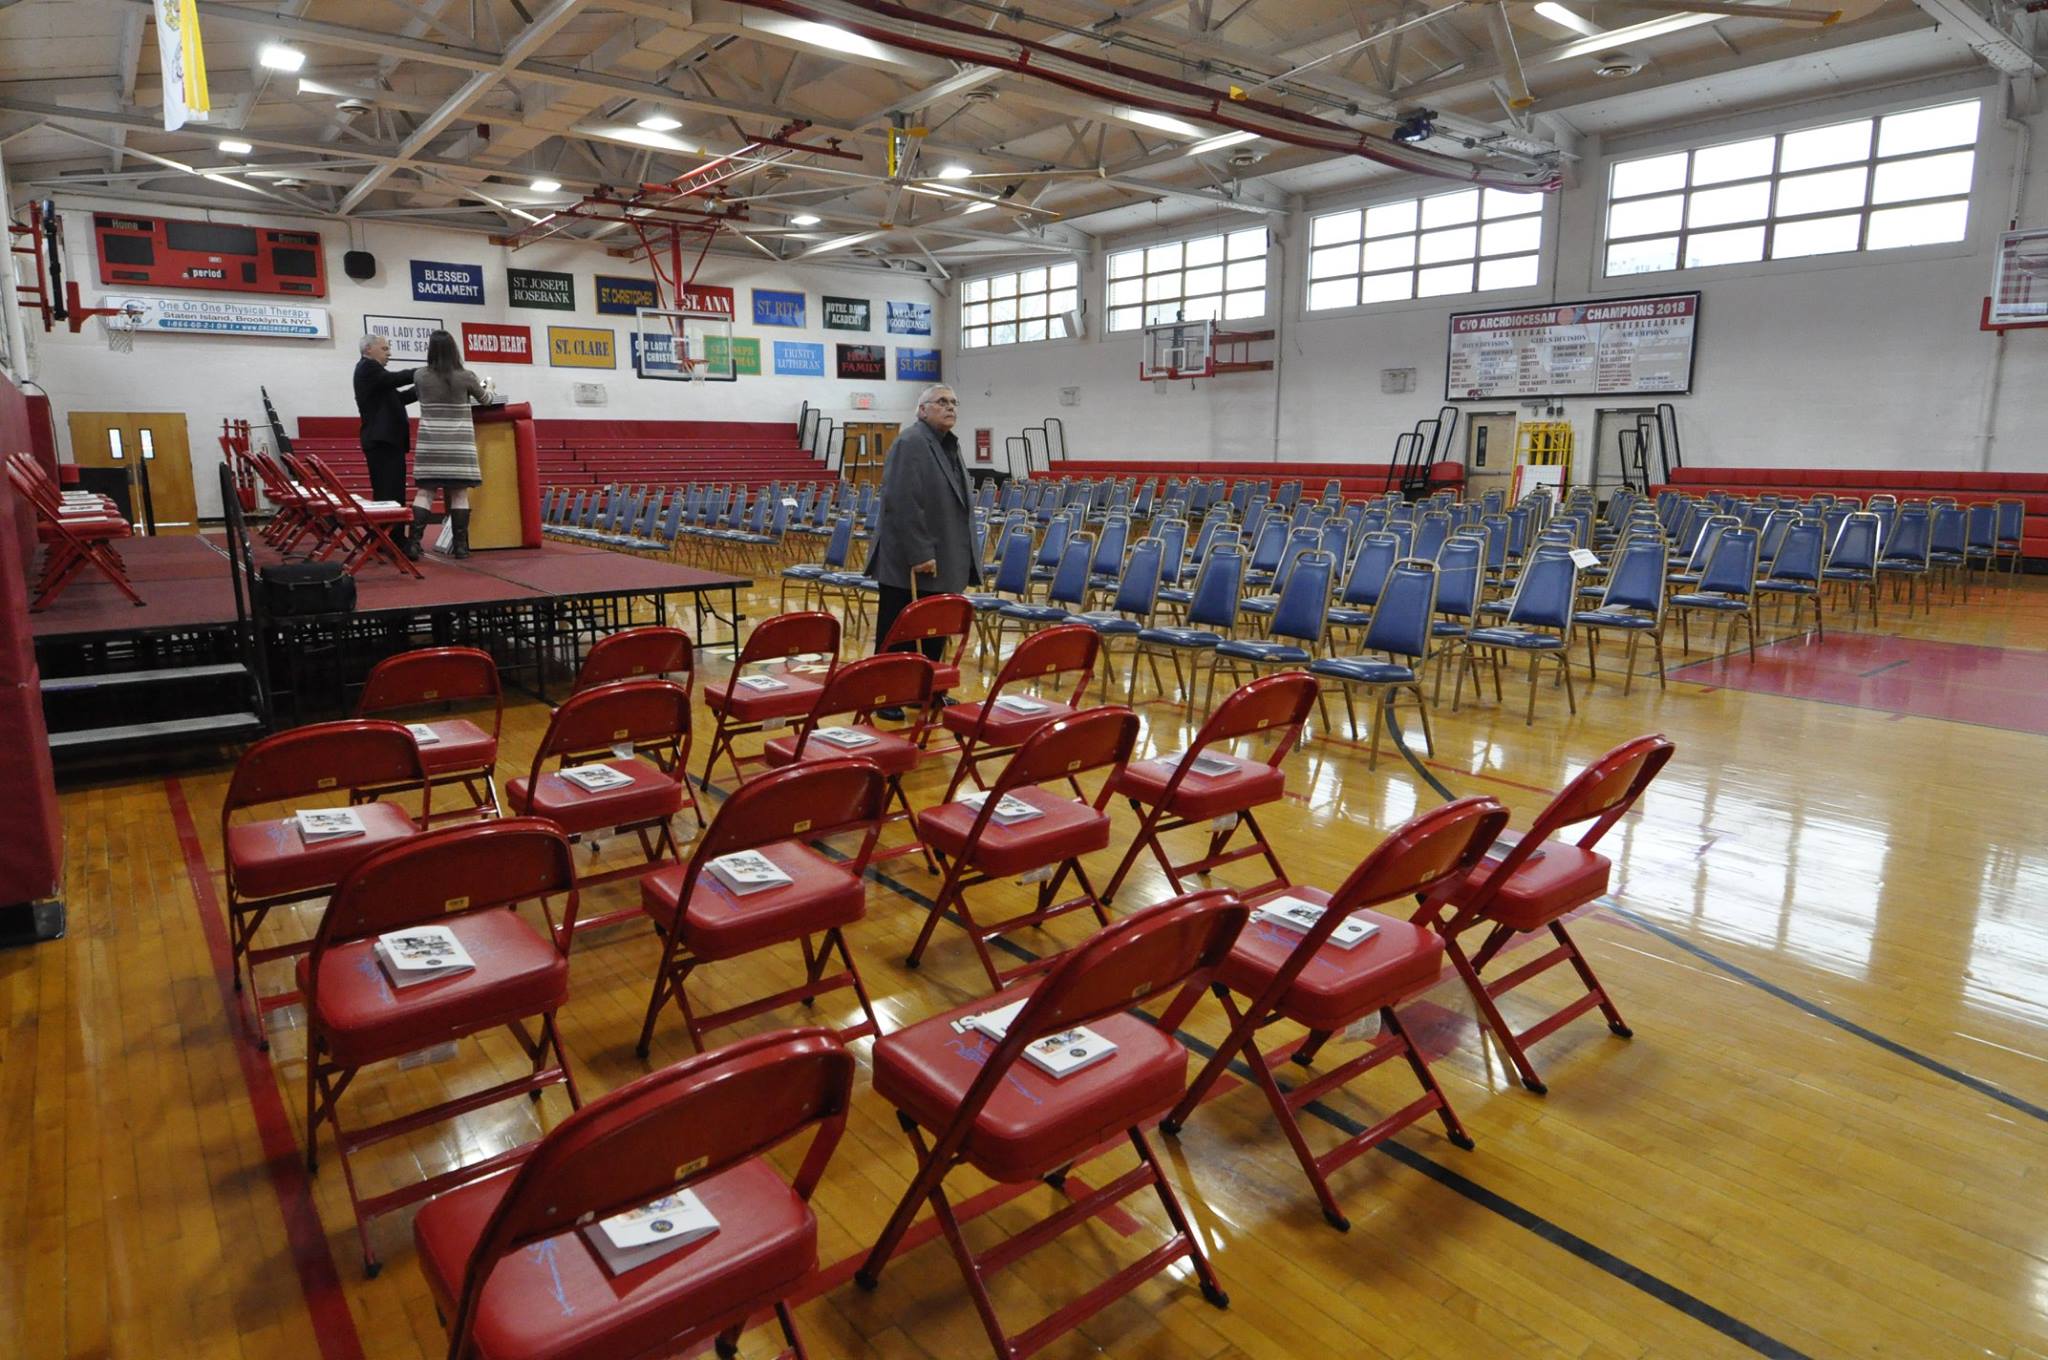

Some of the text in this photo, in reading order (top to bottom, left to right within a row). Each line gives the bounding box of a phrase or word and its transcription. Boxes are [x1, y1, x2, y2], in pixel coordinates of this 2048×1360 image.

[193, 269, 222, 278] period
[424, 269, 470, 283] BLESSED
[417, 281, 479, 296] SACRAMENT
[513, 276, 569, 291] ST. JOSEPH
[514, 289, 570, 303] ROSEBANK
[612, 288, 653, 305] CHRISTOPHER
[682, 293, 729, 312] ST. ANN
[159, 300, 311, 318] One On One Physical Therapy
[775, 301, 802, 320] RITA
[825, 303, 847, 313] NOTRE
[163, 311, 198, 319] Staten
[200, 313, 232, 321] Island,
[235, 315, 279, 324] Brooklyn
[832, 314, 863, 325] ACADEMY
[1460, 301, 1686, 331] CYO ARCHDIOCESAN CHAMPIONS 2018
[1609, 318, 1685, 330] CHEERLEADING
[373, 325, 390, 336] OUR
[393, 325, 414, 338] LADY
[1493, 328, 1552, 338] BASKETBALL
[397, 340, 411, 351] THE
[468, 333, 526, 354] SACRED HEART
[555, 339, 609, 356] ST. CLARE
[650, 341, 668, 351] LADY
[784, 348, 815, 360] TRINITY
[777, 358, 821, 369] LUTHERAN
[841, 361, 880, 372] FAMILY
